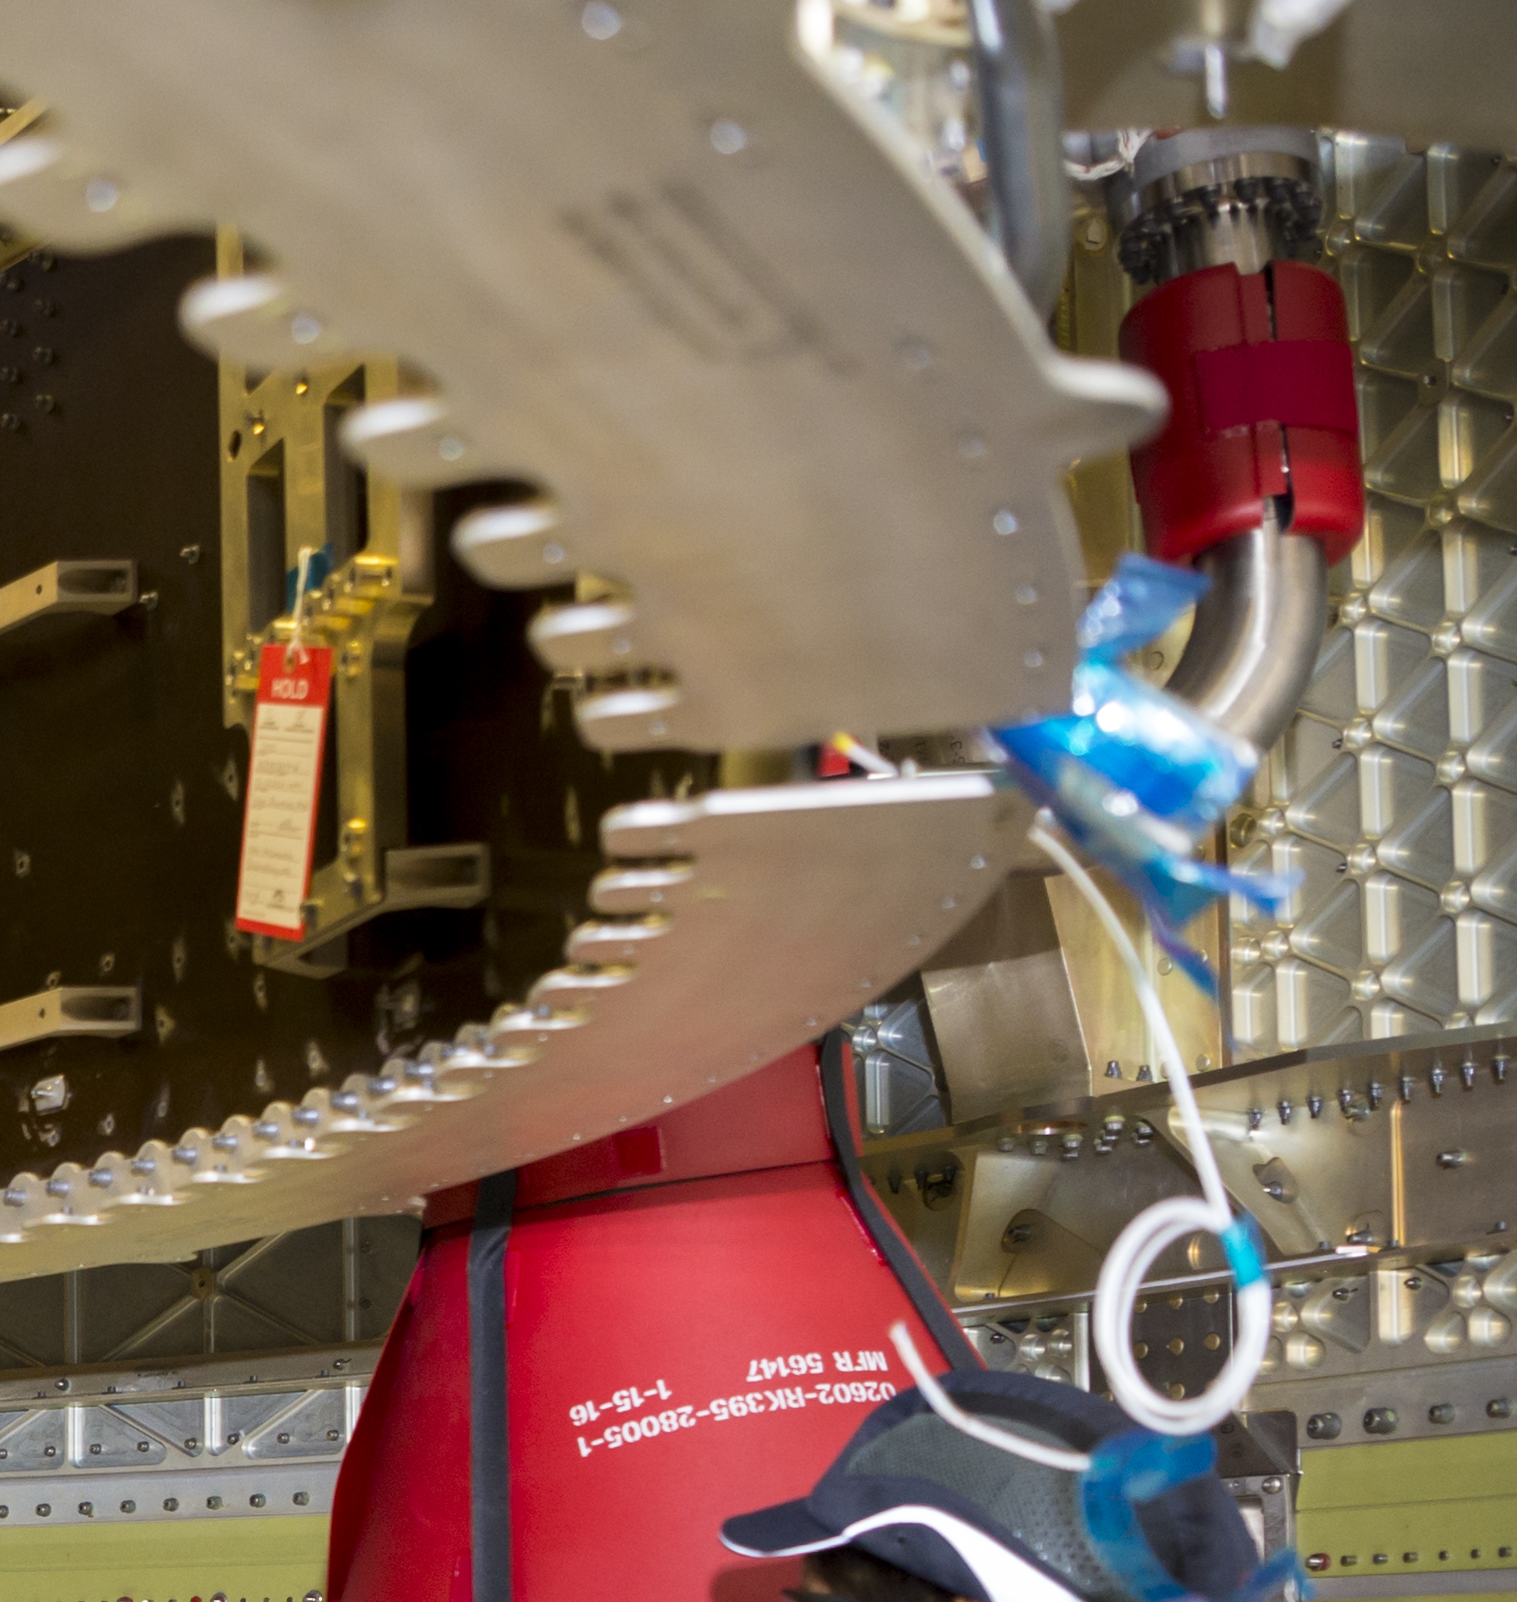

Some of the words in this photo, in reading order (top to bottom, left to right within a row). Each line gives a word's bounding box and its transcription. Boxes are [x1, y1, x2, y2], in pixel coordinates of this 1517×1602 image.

[270, 679, 309, 700] HOLD
[746, 1352, 825, 1382] 56147
[832, 1351, 889, 1372] MFR
[569, 1378, 673, 1427] 1-15-16
